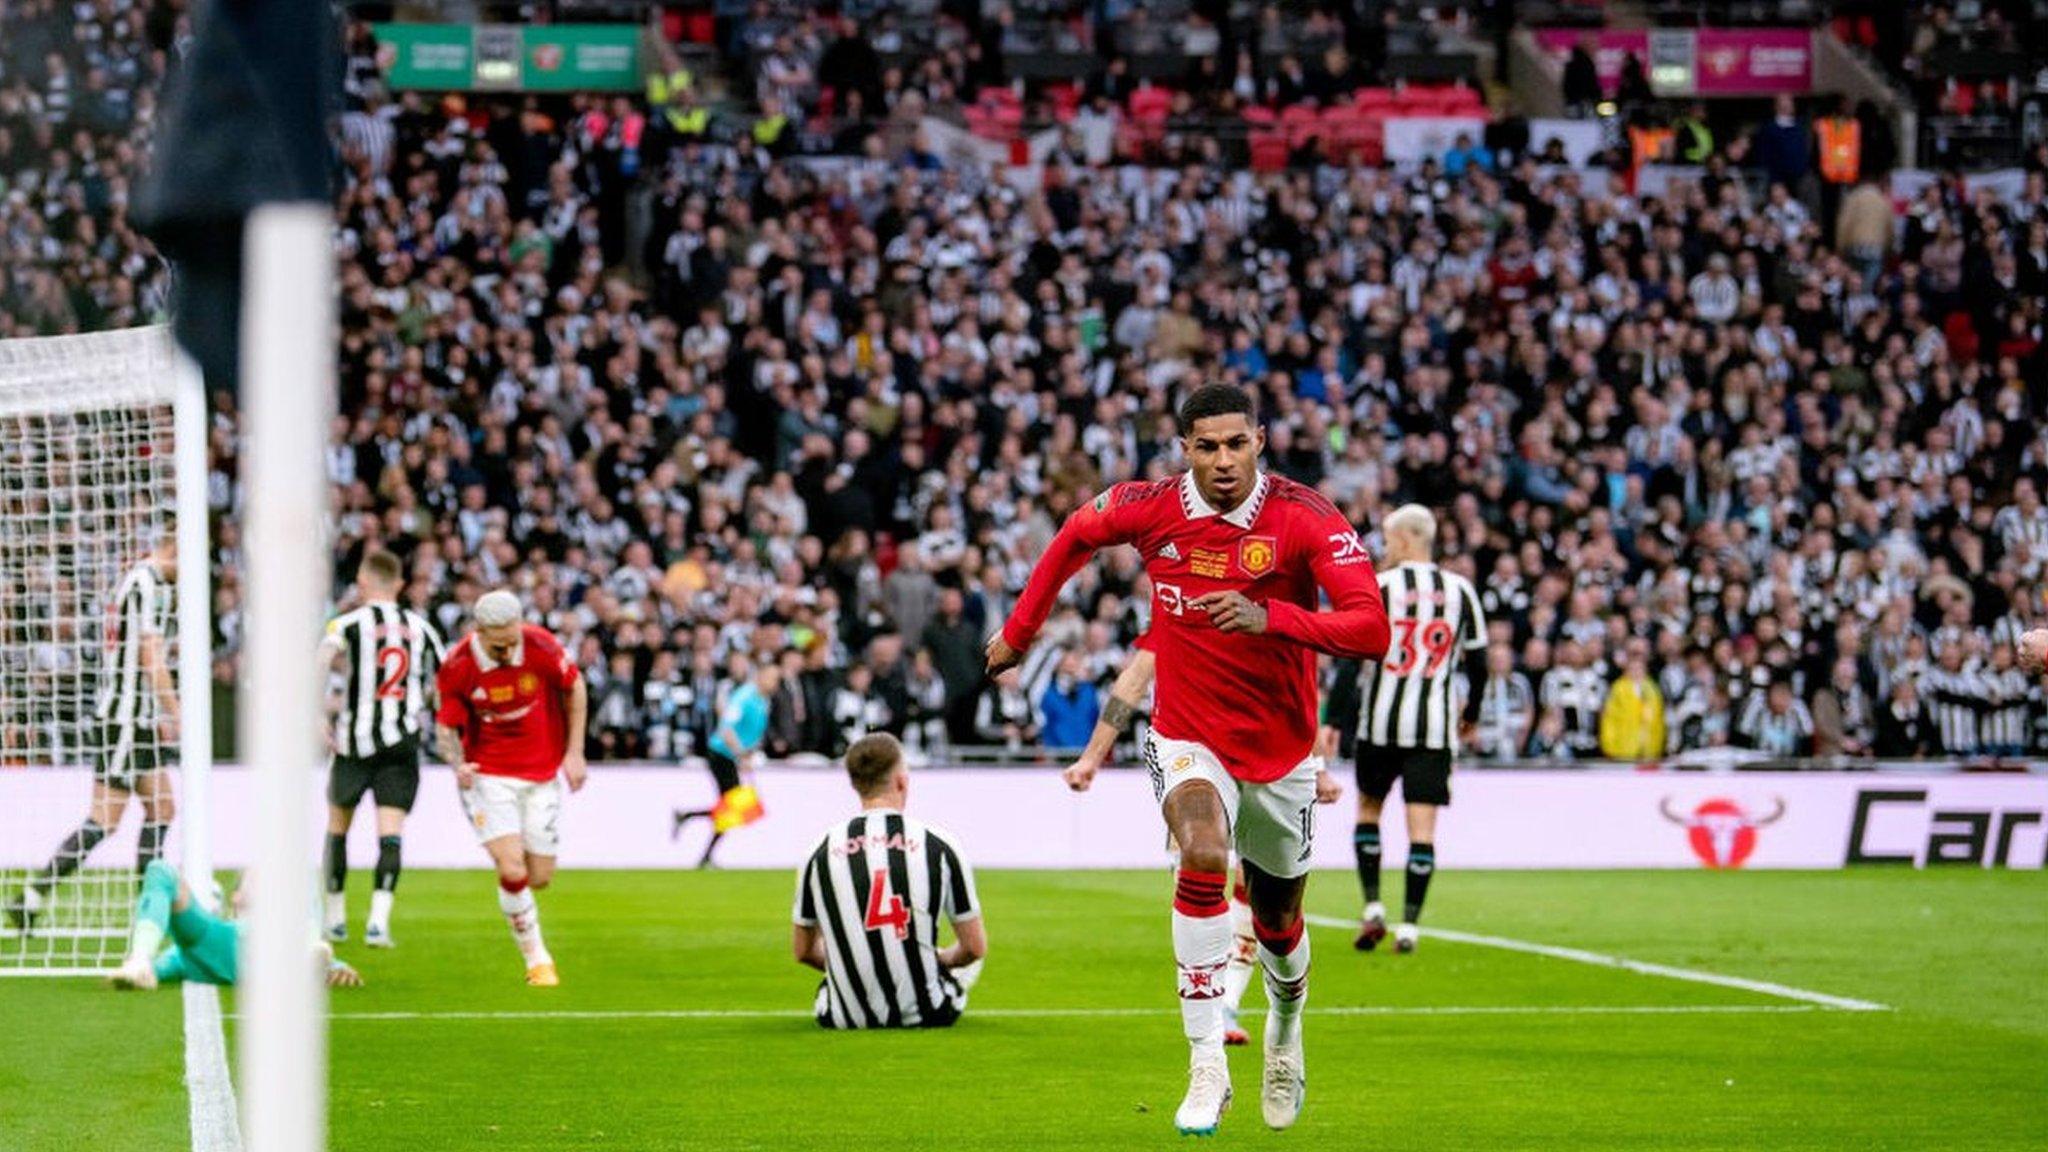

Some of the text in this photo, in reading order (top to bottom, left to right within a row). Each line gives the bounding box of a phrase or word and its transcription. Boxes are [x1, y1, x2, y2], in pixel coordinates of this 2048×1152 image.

[374, 645, 410, 701] 2
[1385, 617, 1454, 679] 39
[1844, 789, 2048, 866] Car
[864, 868, 911, 939] 4
